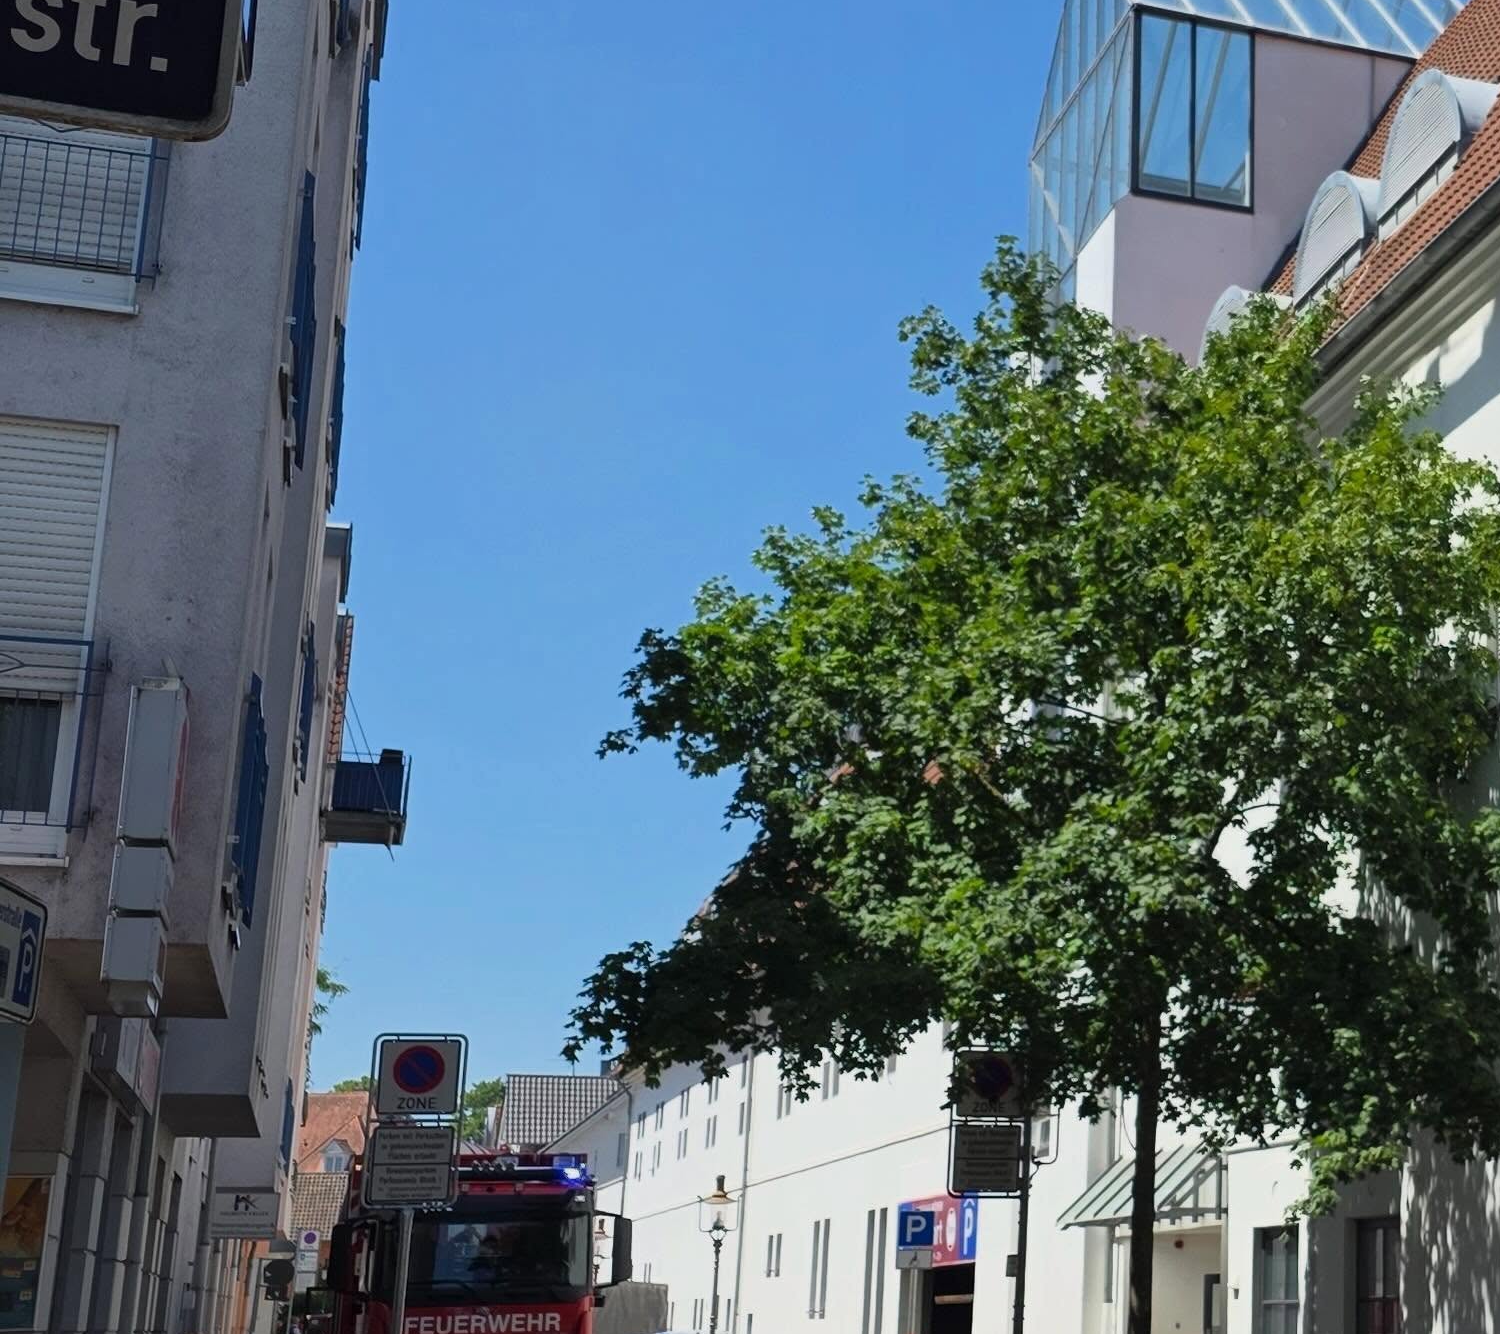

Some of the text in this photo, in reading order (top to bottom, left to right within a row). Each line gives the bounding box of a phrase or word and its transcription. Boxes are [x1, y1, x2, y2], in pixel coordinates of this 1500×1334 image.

[397, 1097, 438, 1110] ZONE
[972, 1101, 1006, 1113] ZONE
[905, 1214, 928, 1243] P
